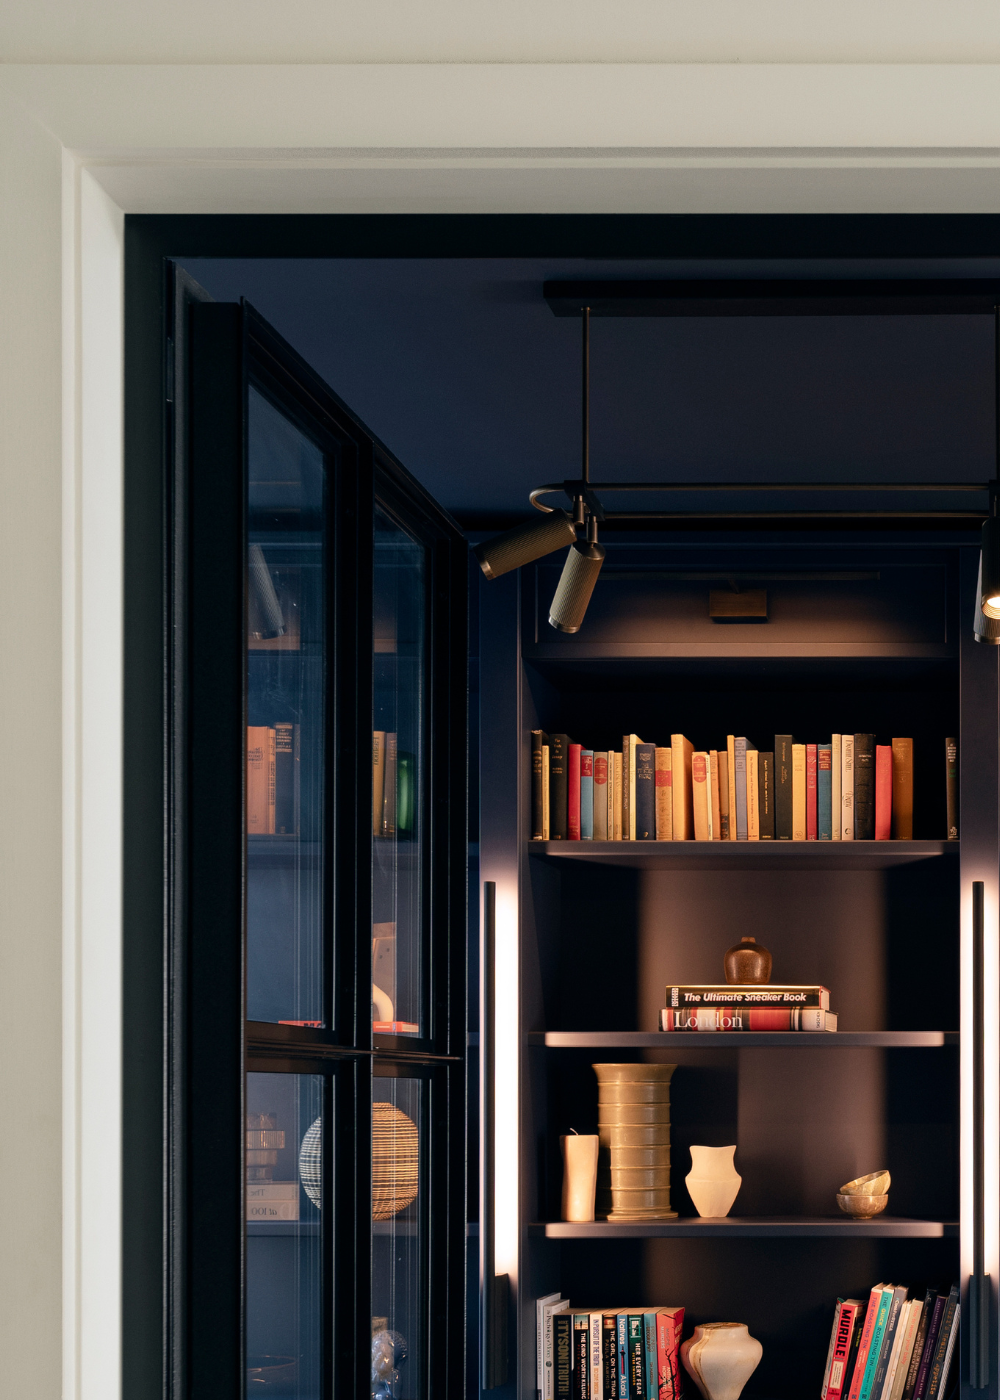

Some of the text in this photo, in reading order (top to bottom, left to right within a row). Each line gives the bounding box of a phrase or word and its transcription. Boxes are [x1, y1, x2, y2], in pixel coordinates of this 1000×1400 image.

[684, 993, 701, 1002] The
[703, 992, 742, 1002] Ultimate
[745, 992, 782, 1002] Sneaker
[783, 992, 807, 1002] Book
[674, 1012, 742, 1028] London
[864, 1309, 875, 1338] ROASTING
[878, 1308, 886, 1326] QUICK
[557, 1325, 570, 1360] TYSON
[836, 1309, 852, 1357] MURDLE
[872, 1327, 882, 1355] ROASTING
[611, 1358, 616, 1366] ON
[558, 1364, 570, 1392] TRUTH
[620, 1374, 628, 1396] Akala
